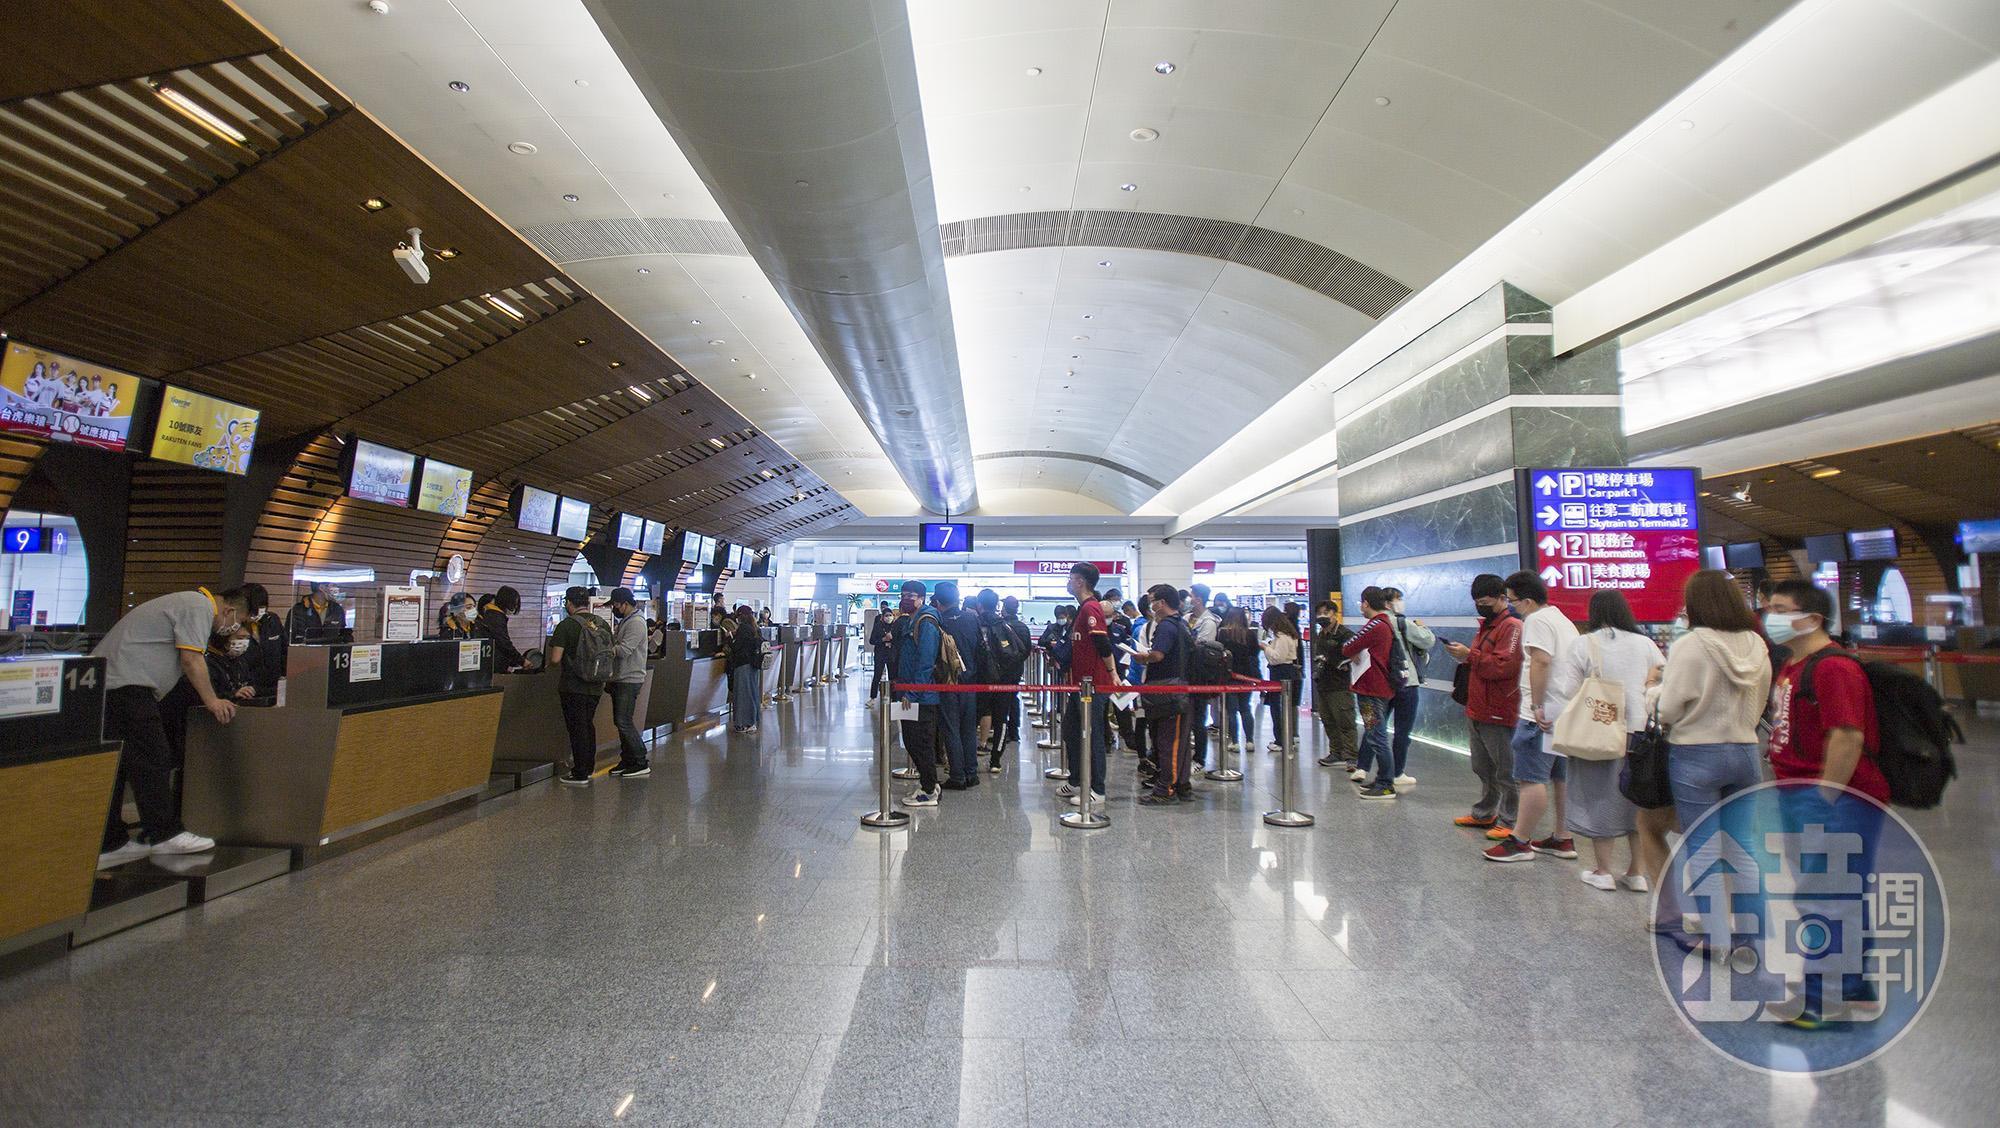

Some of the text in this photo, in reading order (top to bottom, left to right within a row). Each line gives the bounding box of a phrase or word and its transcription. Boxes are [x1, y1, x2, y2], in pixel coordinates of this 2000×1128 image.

[1586, 472, 1654, 487] 1號停車場
[1631, 488, 1638, 497] 1
[1590, 502, 1688, 517] 往第二航廈電車
[1588, 518, 1689, 530] Skytrain to Terminal 2
[17, 530, 30, 551] 9
[939, 526, 954, 549] 7
[1590, 533, 1636, 548] 服務台
[1590, 548, 1646, 558] Information
[1592, 563, 1651, 578] 美食廣場
[1593, 579, 1646, 589] Food court
[481, 645, 492, 658] 12
[333, 652, 350, 669] 13
[65, 667, 97, 691] 14
[1780, 684, 1793, 745] MONKEYS
